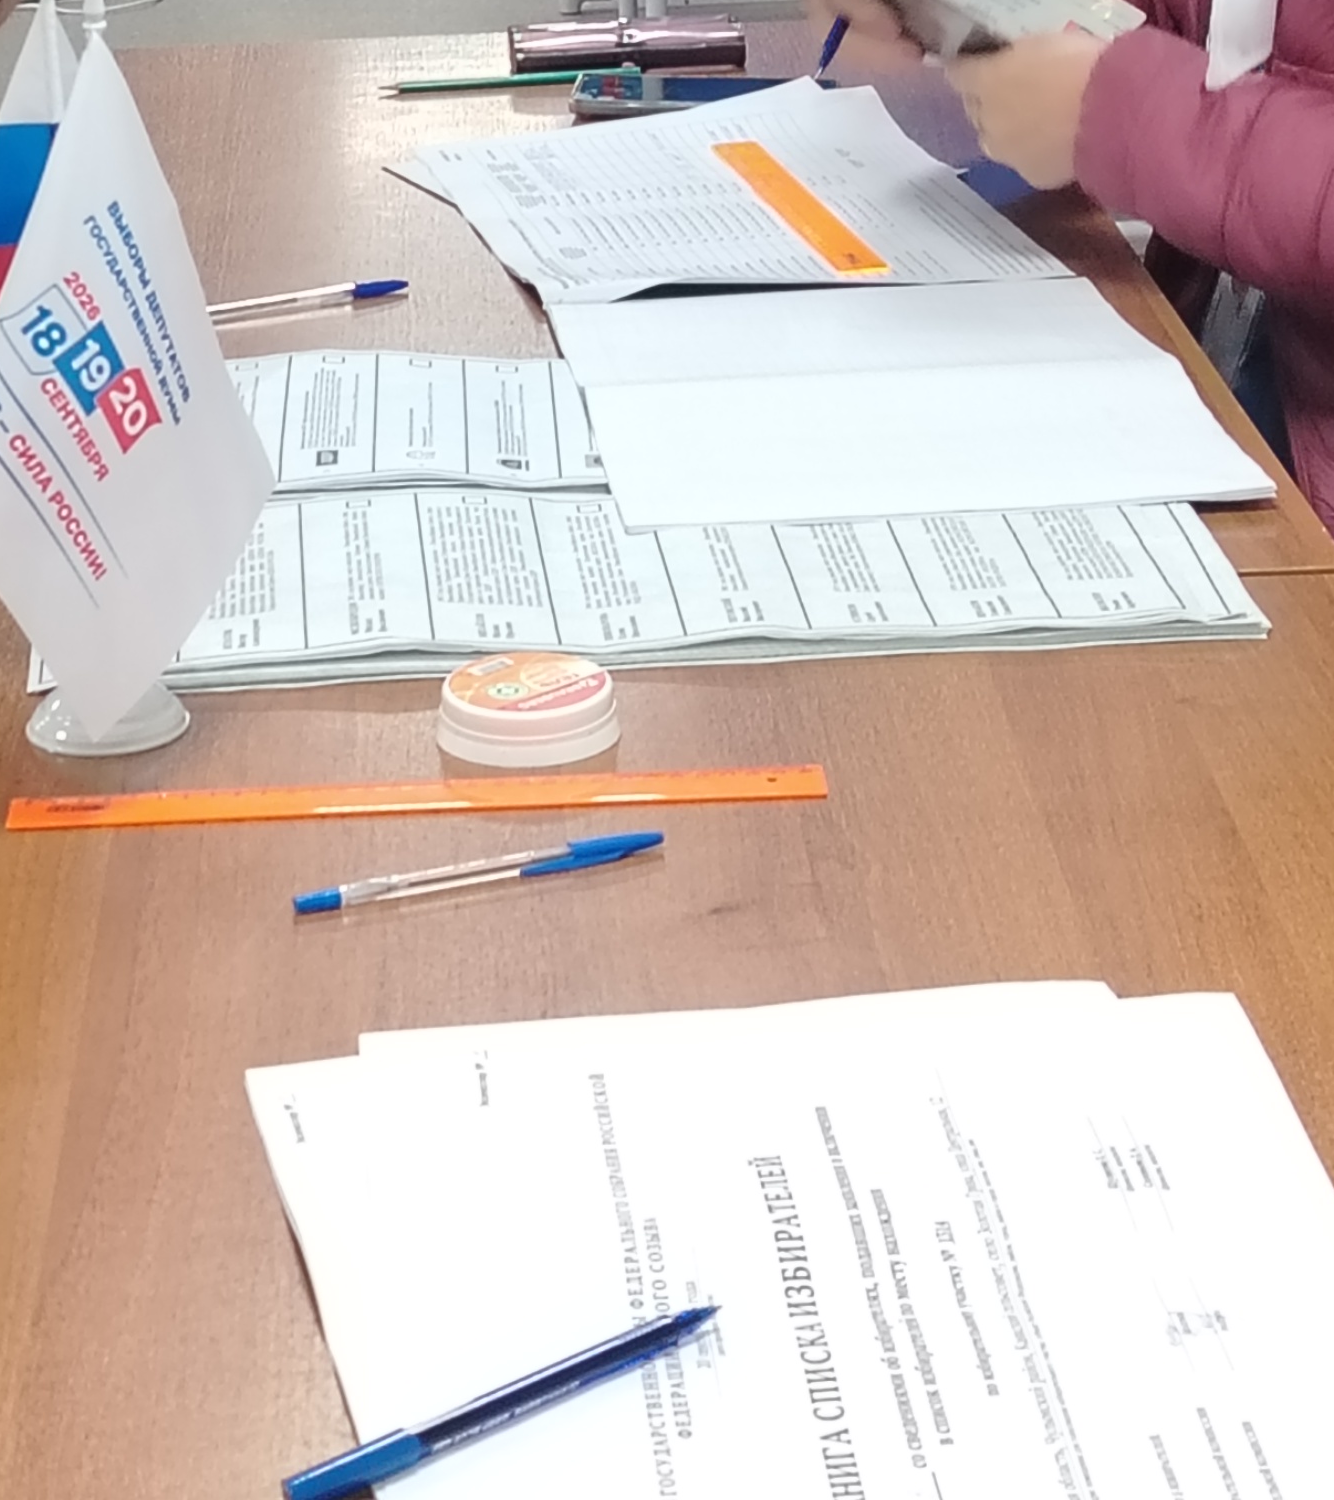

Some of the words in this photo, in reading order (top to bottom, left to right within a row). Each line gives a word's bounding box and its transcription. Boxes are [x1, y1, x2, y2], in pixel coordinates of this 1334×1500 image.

[62, 271, 101, 322] 2026
[82, 214, 165, 375] ГОСУДАРСТВЕННОЙ
[156, 375, 183, 426] ДУМЫ
[106, 200, 158, 291] ВЫБОРЫ
[144, 289, 193, 404] ДЕПУТАТОВ
[19, 304, 68, 358] 18
[69, 338, 112, 391] 19
[109, 378, 149, 438] 20
[40, 378, 109, 482] СЕНТЯБРЯ
[9, 434, 53, 493] СИЛА
[48, 490, 108, 581] РОССИИ!
[589, 1073, 616, 1146] РОССИЙСКОЙ
[614, 1201, 644, 1310] ФЕДЕРАЛЬНОГО
[643, 1217, 666, 1273] СОЗЫВА
[747, 1154, 820, 1318] ИЗБИРАТЕЛЕЙ
[888, 1259, 912, 1299] месту
[642, 1352, 677, 1497] ГОСУДАРСТВЕННО
[795, 1321, 846, 1422] СПИСКА
